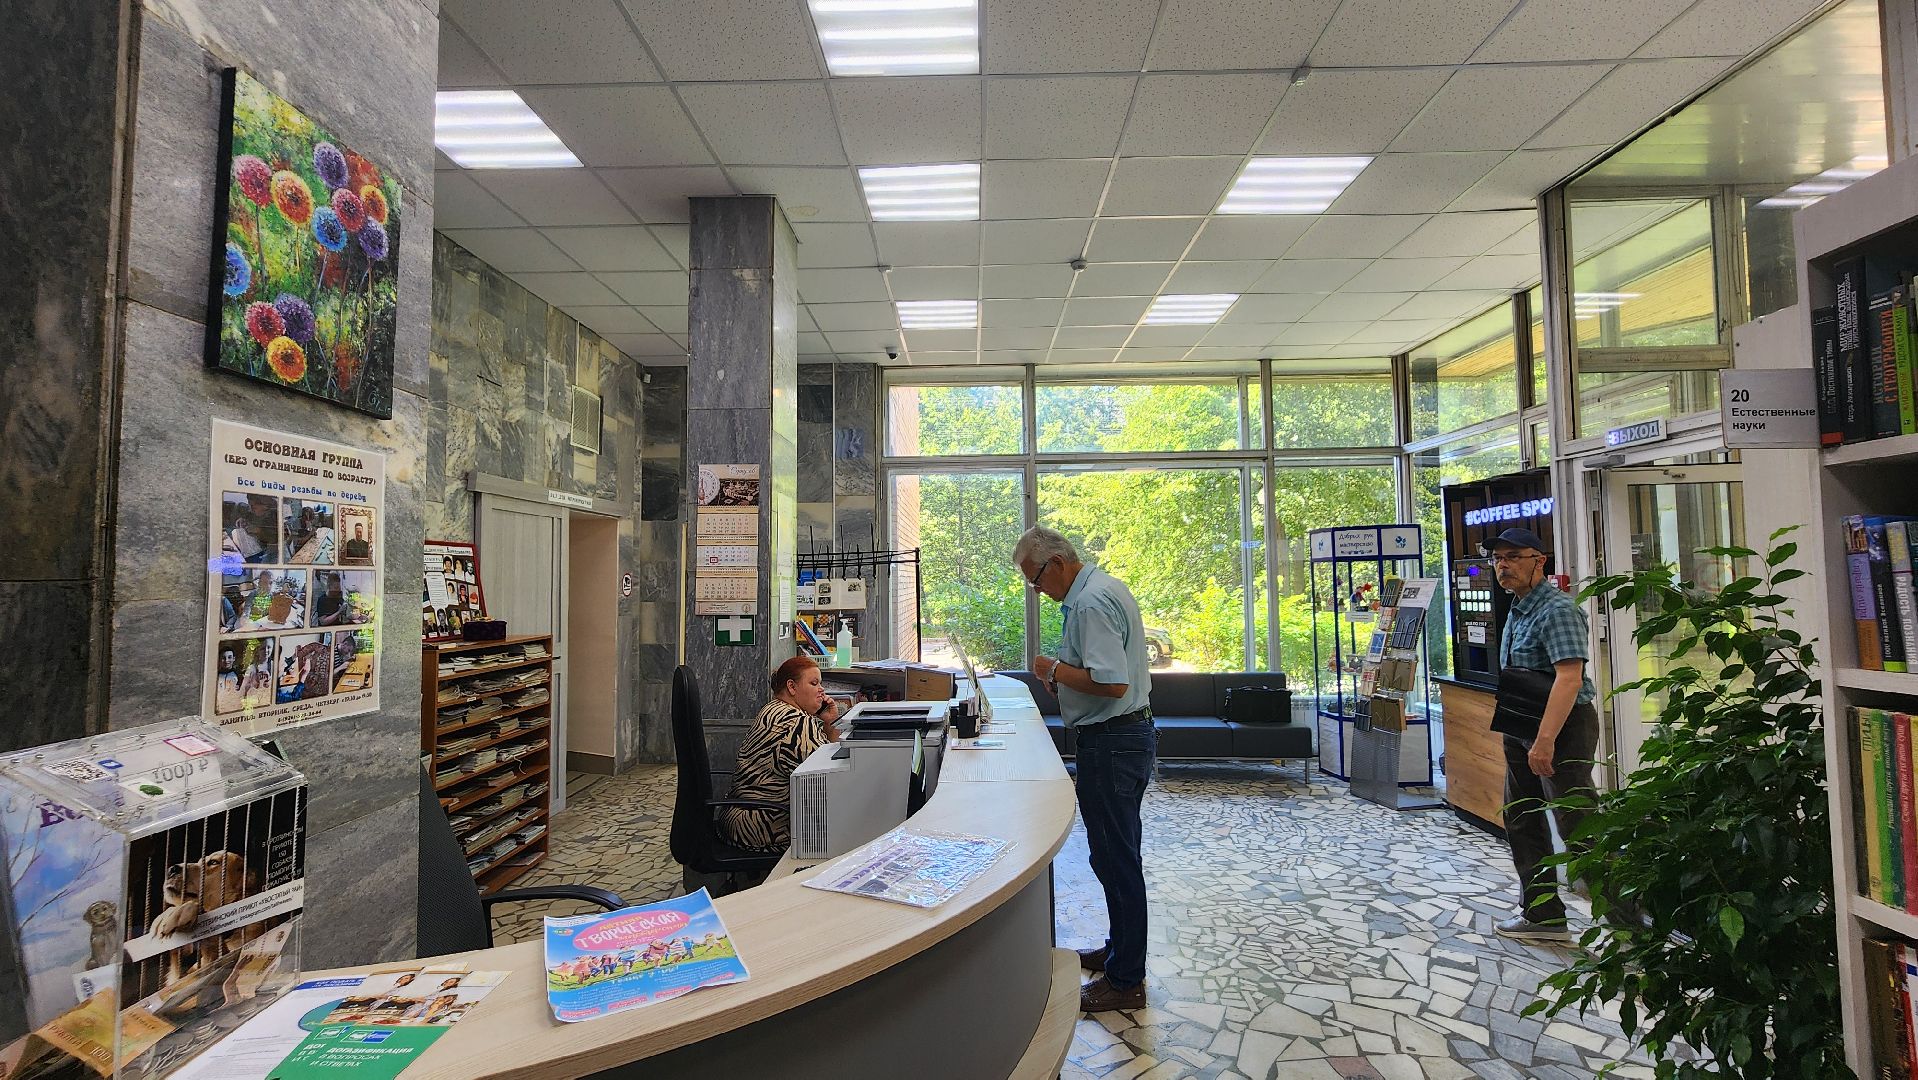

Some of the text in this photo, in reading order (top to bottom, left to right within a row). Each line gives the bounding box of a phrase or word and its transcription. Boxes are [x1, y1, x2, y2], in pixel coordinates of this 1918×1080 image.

[1837, 282, 1846, 332] ЖИВОТНЫХ
[1894, 314, 1903, 335] НАМИ
[1880, 310, 1897, 391] ГЕОГРАФИЕЙ
[1897, 344, 1906, 367] РЯДОМ
[1872, 347, 1883, 403] ИСТОРИИ
[1731, 389, 1750, 403] 20
[1731, 407, 1816, 417] Естественные
[1612, 421, 1660, 446] ВЫХОД
[1732, 421, 1766, 432] науки
[244, 437, 363, 470] ОСНОВНАЯ ГРУППА
[224, 453, 376, 485] (БЕЗ ОГРАНИЧЕНИЯ ПО ВОЗРАСТУ)
[237, 476, 255, 487] Все
[291, 485, 322, 496] резьбы
[327, 490, 337, 498] по
[341, 490, 367, 503] дереву
[1465, 497, 1555, 526] #COFFEE SPO
[1896, 576, 1909, 615] РАДОСТЬ
[1903, 619, 1918, 665] ПОЗНАНИЯ
[152, 762, 193, 784] 1000
[238, 901, 259, 914] ПРИЮТ
[576, 912, 681, 948] ТВОРЧЕСКАЯ
